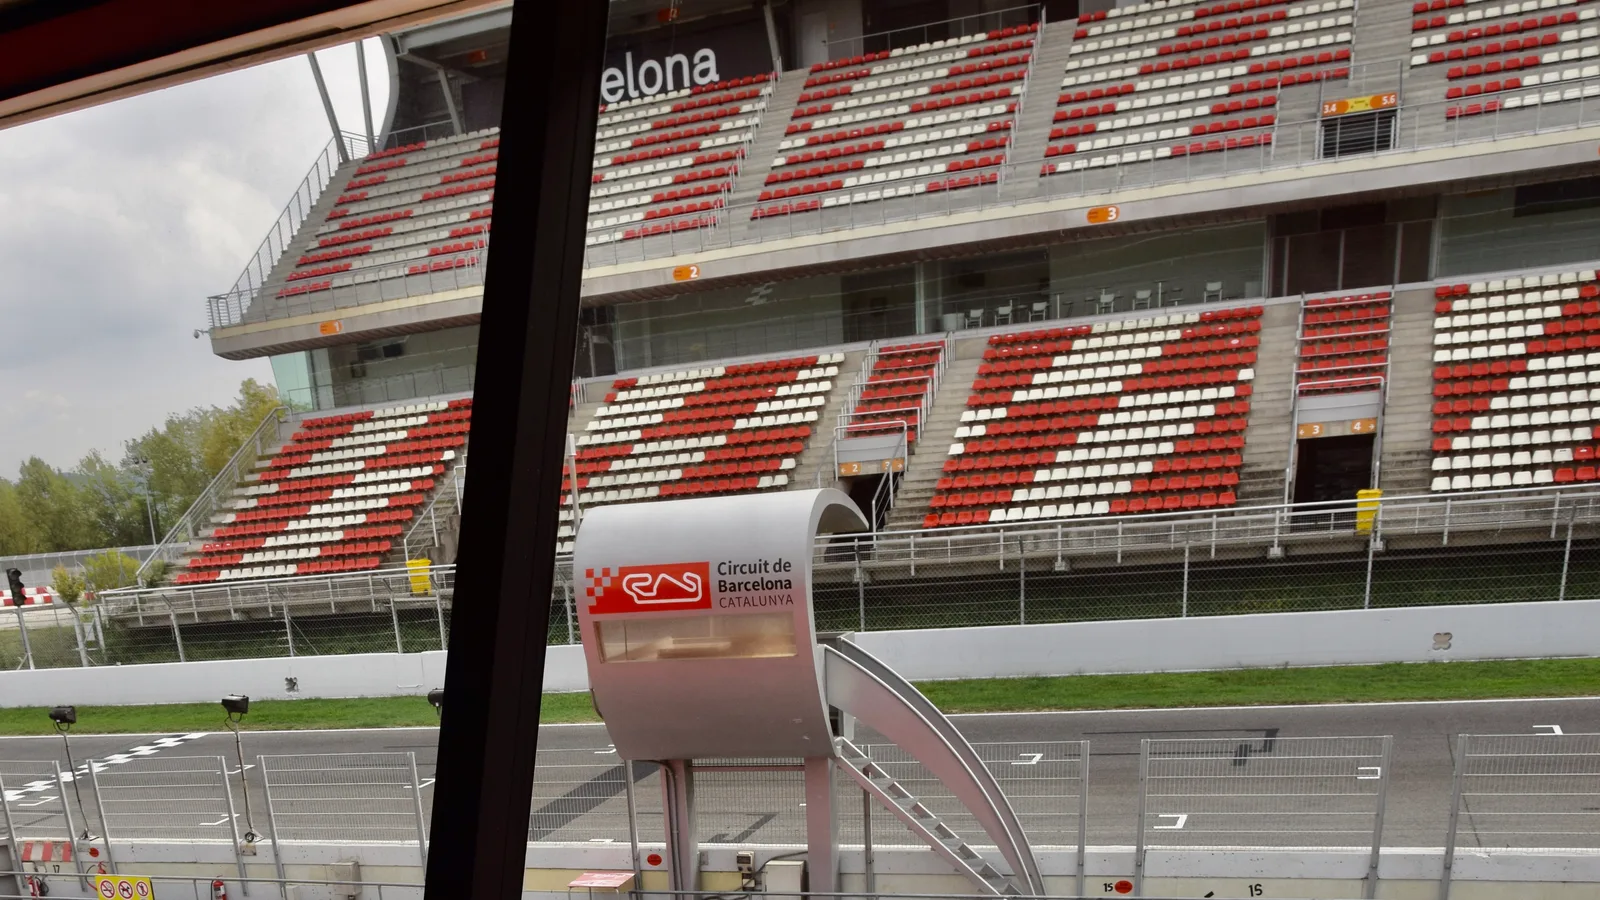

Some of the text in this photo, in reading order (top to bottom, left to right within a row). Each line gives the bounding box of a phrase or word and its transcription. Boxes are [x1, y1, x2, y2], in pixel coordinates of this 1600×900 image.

[1108, 207, 1117, 220] 3
[690, 266, 698, 278] 2
[334, 321, 340, 332] 1
[1312, 422, 1361, 434] 3 4
[852, 464, 858, 473] 2
[717, 558, 792, 576] Circuit de
[717, 577, 793, 593] Barcelona
[719, 594, 794, 608] CATALUNYA
[1103, 882, 1114, 892] 15
[1248, 883, 1263, 897] 15
